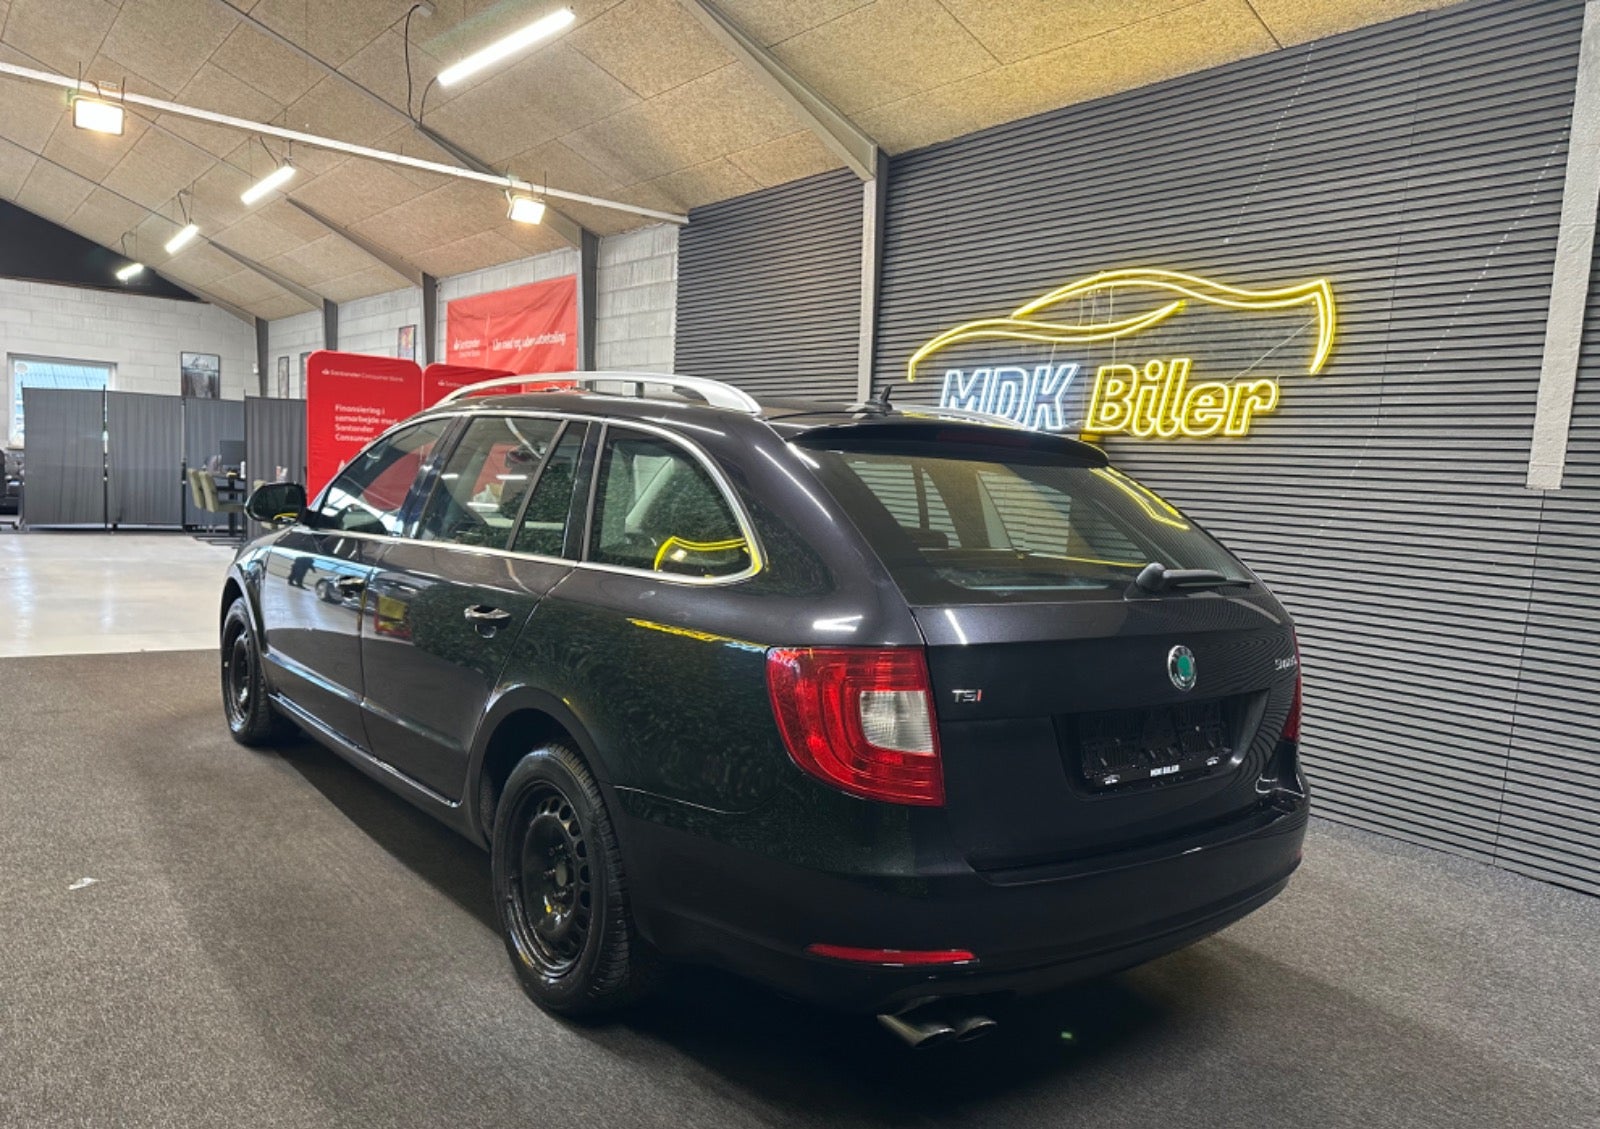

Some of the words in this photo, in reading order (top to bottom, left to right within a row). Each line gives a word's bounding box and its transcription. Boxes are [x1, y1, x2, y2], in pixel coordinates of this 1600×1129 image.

[938, 363, 1080, 432] MDK
[1084, 357, 1281, 438] Biler
[335, 403, 381, 416] Finansiering
[335, 423, 375, 434] Santander
[951, 689, 983, 703] TSI
